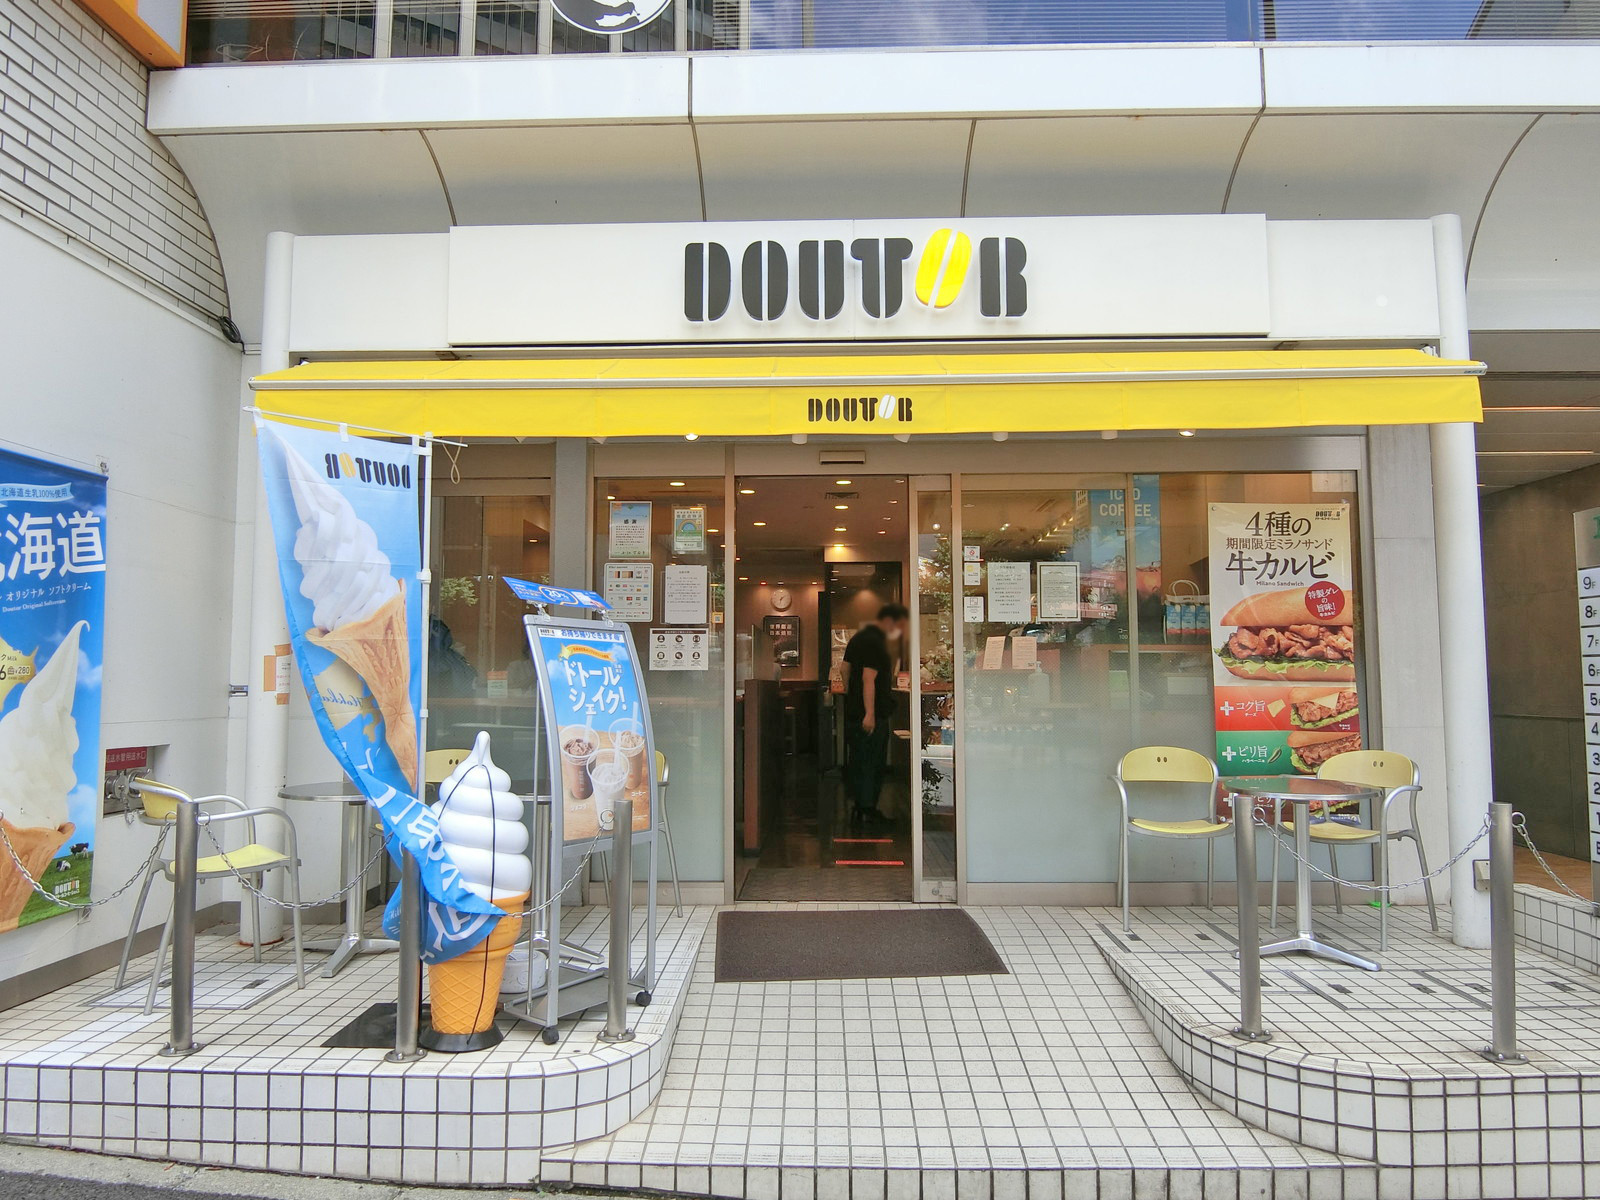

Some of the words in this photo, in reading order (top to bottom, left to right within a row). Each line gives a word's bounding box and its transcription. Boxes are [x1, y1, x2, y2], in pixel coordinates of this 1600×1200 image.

[684, 228, 1028, 322] DOUTOR
[808, 394, 913, 422] DOUTOR
[1109, 488, 1141, 500] ICD
[1100, 503, 1152, 517] COFEE
[1245, 511, 1312, 537] 4種の
[0, 510, 107, 581] 海道
[1226, 537, 1333, 551] 期間限定ミラノサンド
[1225, 550, 1336, 586] 牛カルビ
[6, 589, 45, 602] オリジナル
[49, 582, 92, 595] ソフトクリーム
[1307, 587, 1339, 600] 特製ダレ
[563, 660, 621, 688] ドトール
[568, 685, 628, 715] シェイク!
[1238, 745, 1268, 758] ピリ旨
